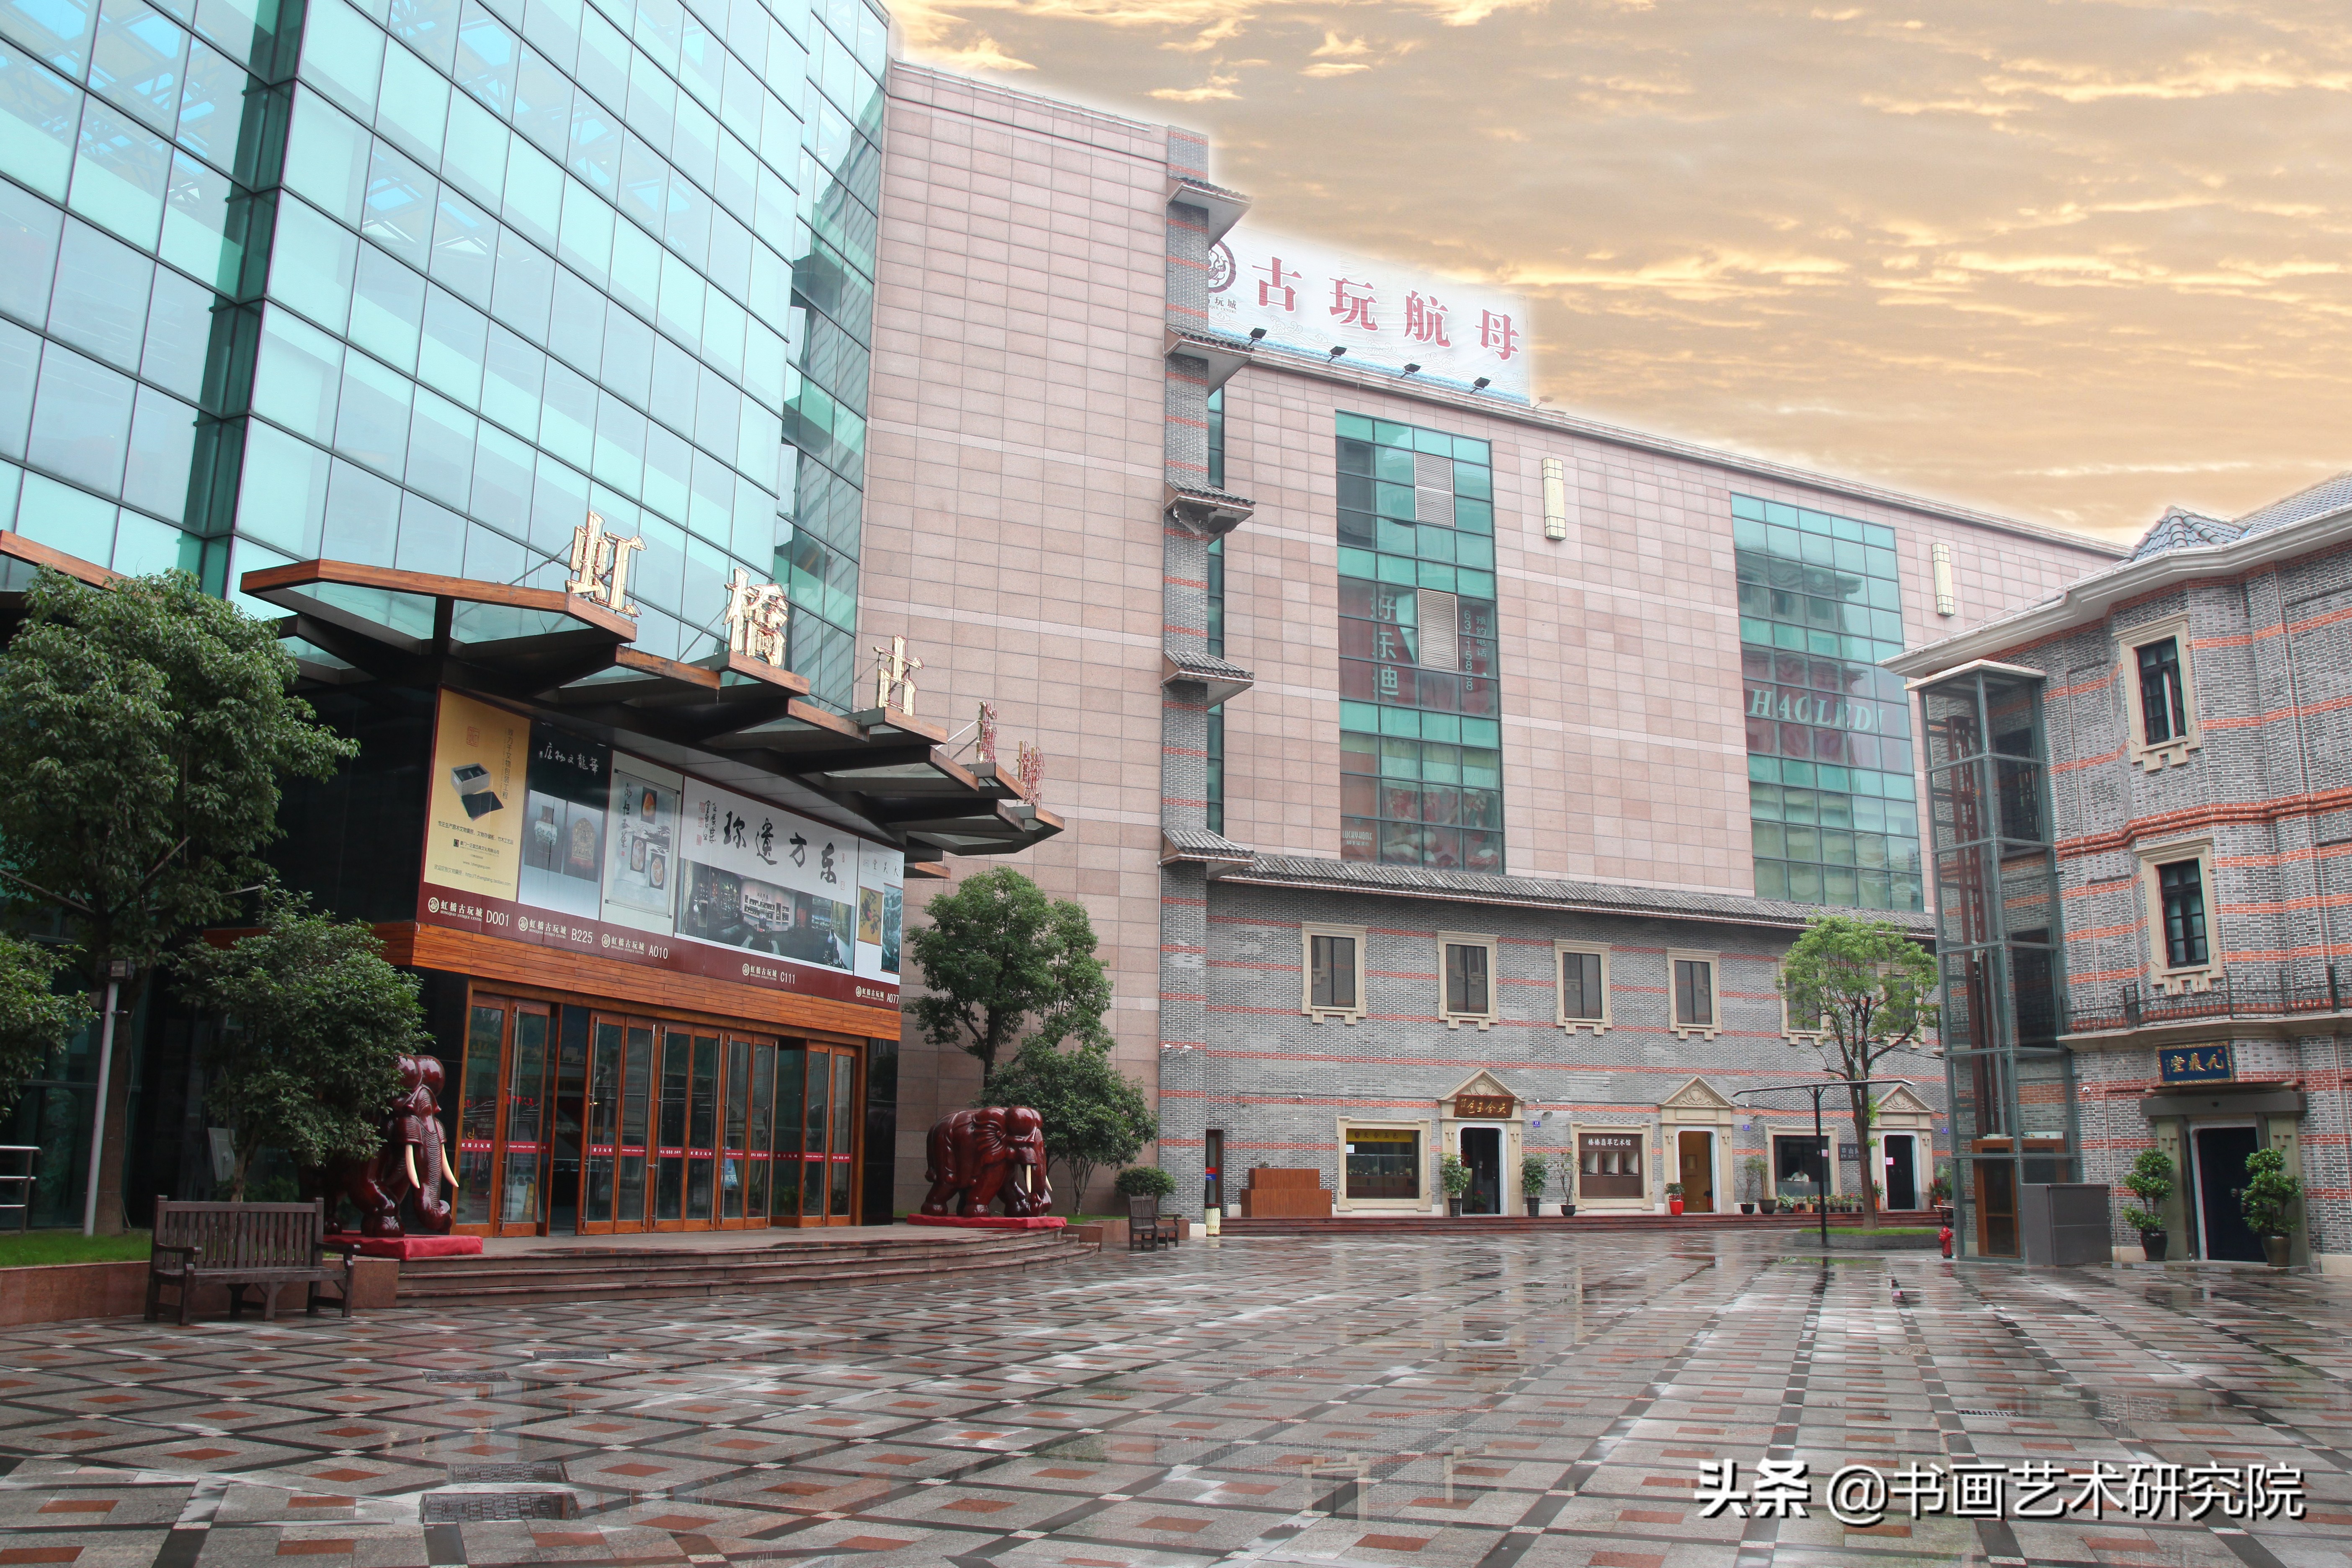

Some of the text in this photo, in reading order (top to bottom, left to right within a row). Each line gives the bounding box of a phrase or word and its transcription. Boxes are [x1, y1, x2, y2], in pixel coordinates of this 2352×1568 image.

[1252, 256, 1521, 362] 古玩航母
[1475, 615, 1487, 658] 预约电话
[1370, 594, 1399, 703] 好乐迪
[502, 728, 513, 800] 致力于文物包装工程
[486, 910, 510, 927] D001
[572, 928, 593, 944] B225
[649, 945, 668, 959] A010
[780, 972, 795, 984] C111
[887, 994, 899, 1004] A077
